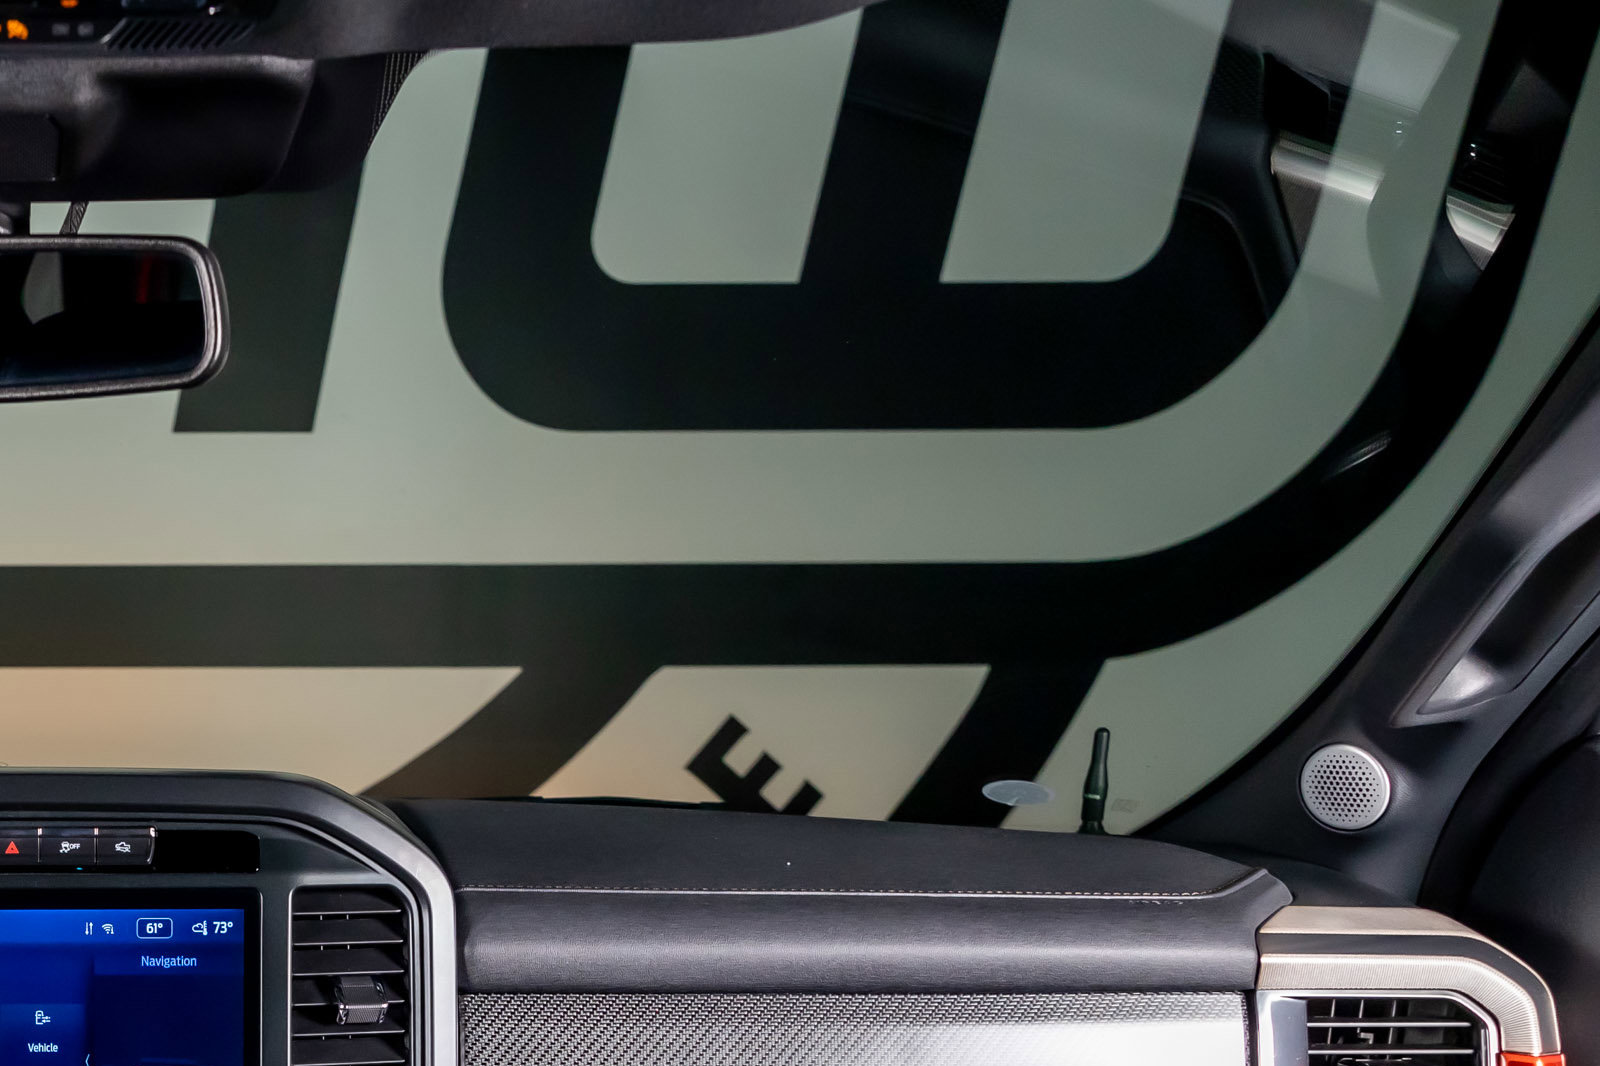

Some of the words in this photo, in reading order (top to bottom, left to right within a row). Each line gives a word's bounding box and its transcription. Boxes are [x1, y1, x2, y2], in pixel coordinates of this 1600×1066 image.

[145, 921, 164, 935] 61°
[212, 920, 234, 934] 73°
[140, 955, 198, 969] Navigation
[27, 1042, 59, 1053] Vehicle
